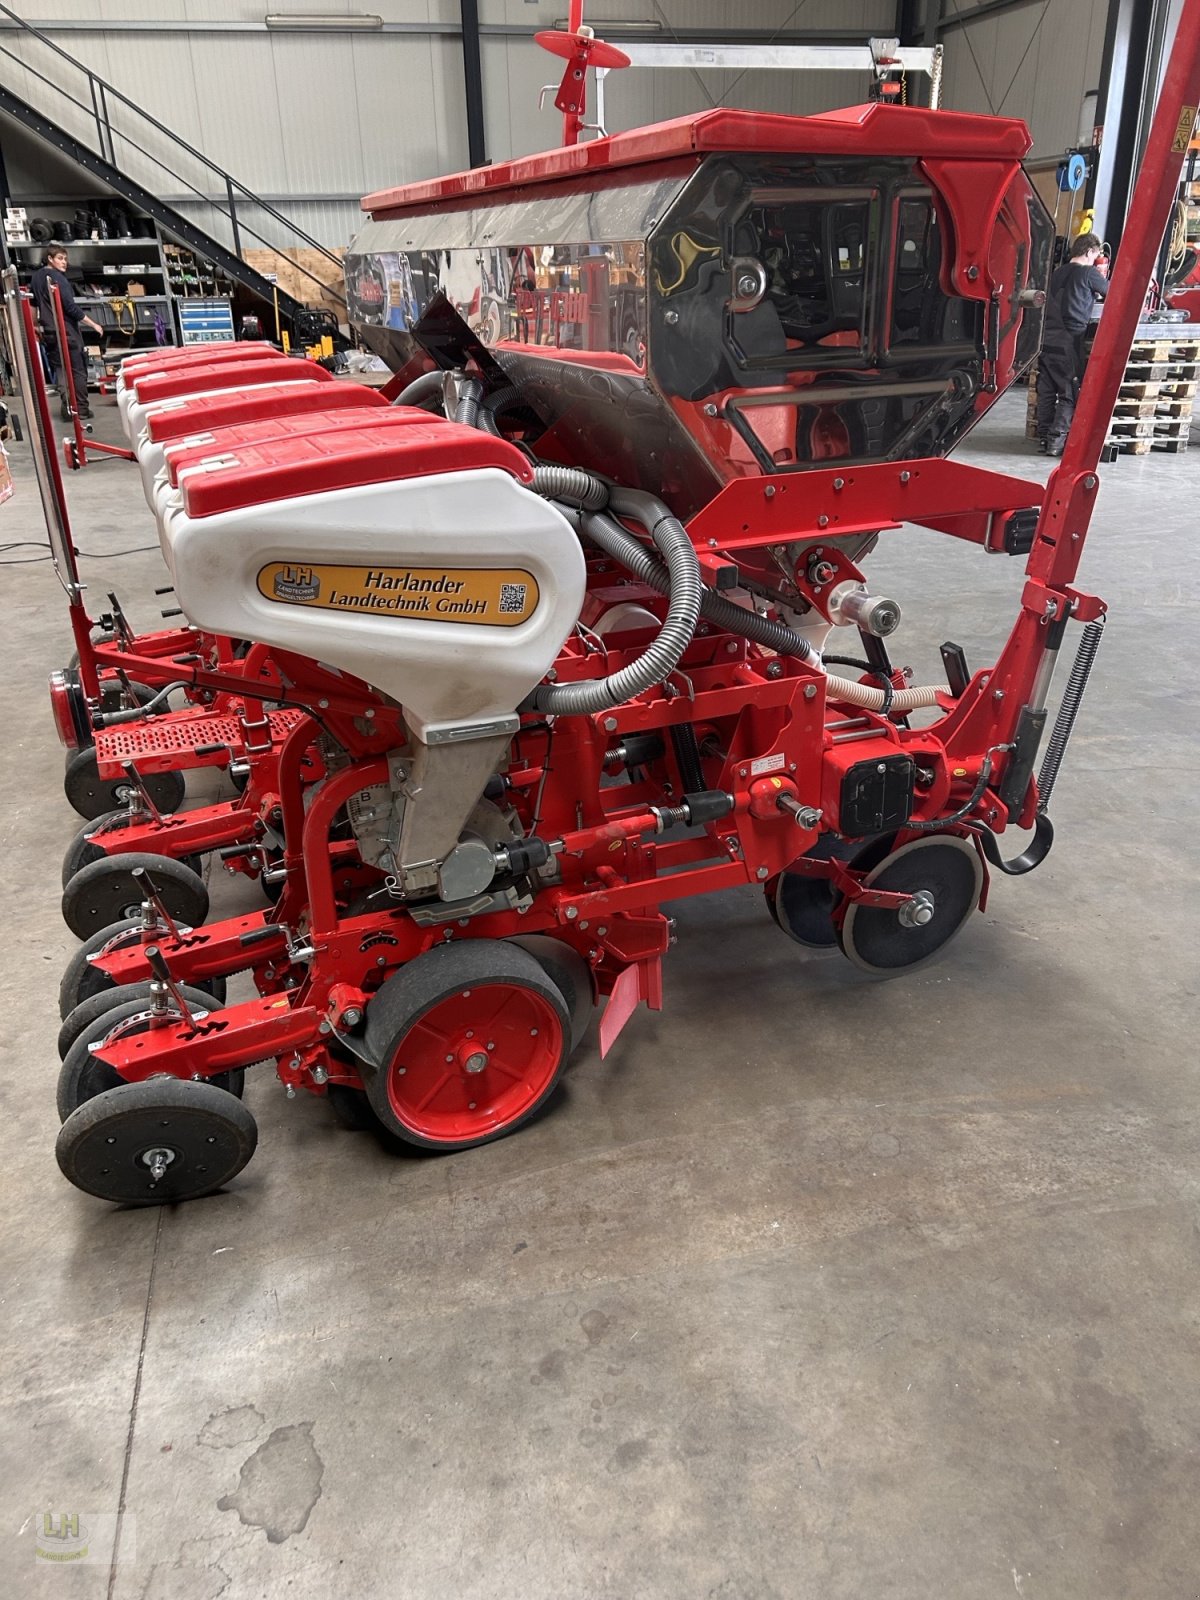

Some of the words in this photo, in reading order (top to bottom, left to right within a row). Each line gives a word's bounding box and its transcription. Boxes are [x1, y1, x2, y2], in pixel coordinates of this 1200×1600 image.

[283, 566, 312, 586] LH
[364, 571, 465, 594] Harlander
[328, 591, 432, 612] Landtechnik
[435, 598, 488, 615] GmbH
[361, 792, 371, 801] B
